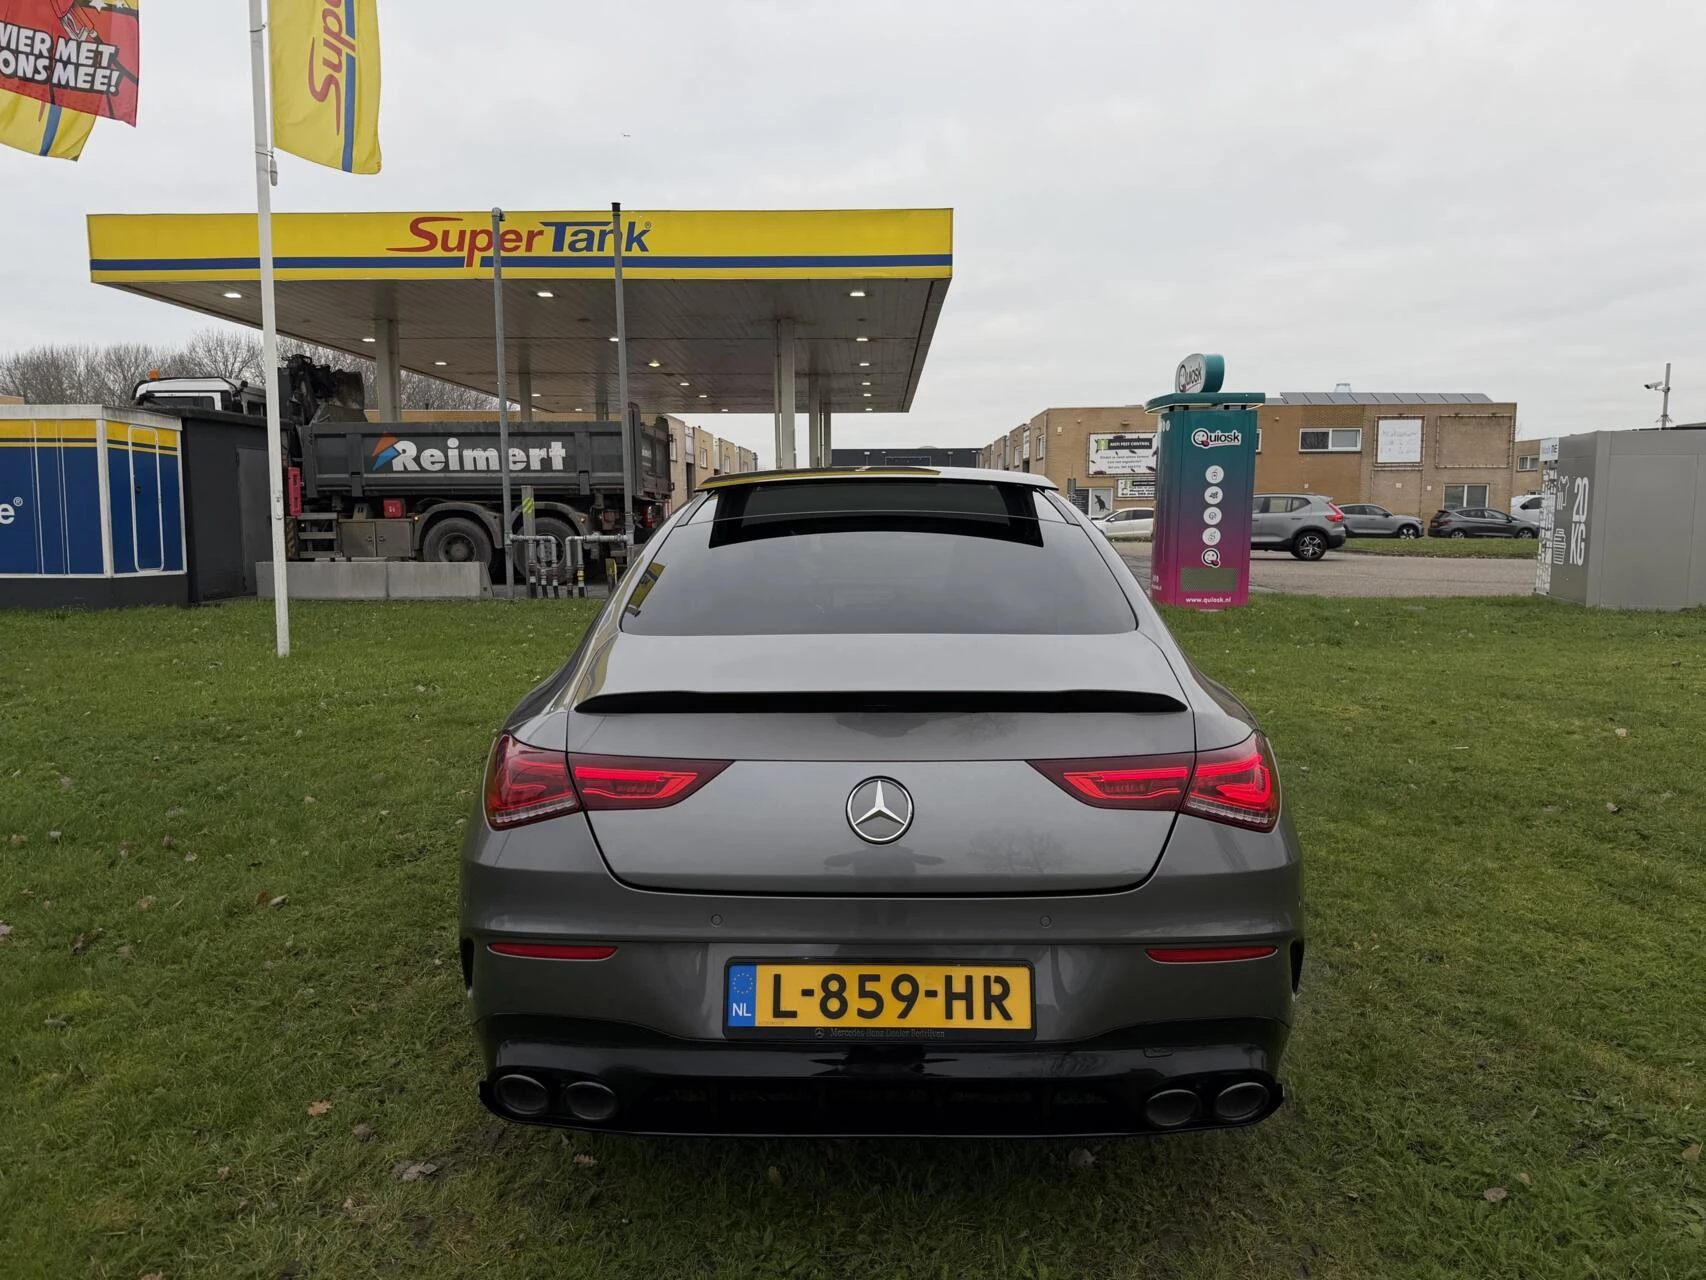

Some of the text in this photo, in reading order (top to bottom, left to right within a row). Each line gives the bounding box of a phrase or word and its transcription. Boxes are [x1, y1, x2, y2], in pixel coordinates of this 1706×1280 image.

[55, 37, 116, 67] MET
[308, 0, 356, 136] Sup
[0, 49, 120, 93] ONS MEE!
[1178, 361, 1202, 393] Quiosk
[391, 437, 567, 472] Reimert
[1192, 429, 1240, 448] Quiosk
[1572, 476, 1589, 523] 20
[1569, 523, 1586, 566] KG
[1185, 596, 1232, 604] www.quiosk.nl
[732, 1003, 752, 1017] NL
[772, 973, 1014, 1021] L-859-HR
